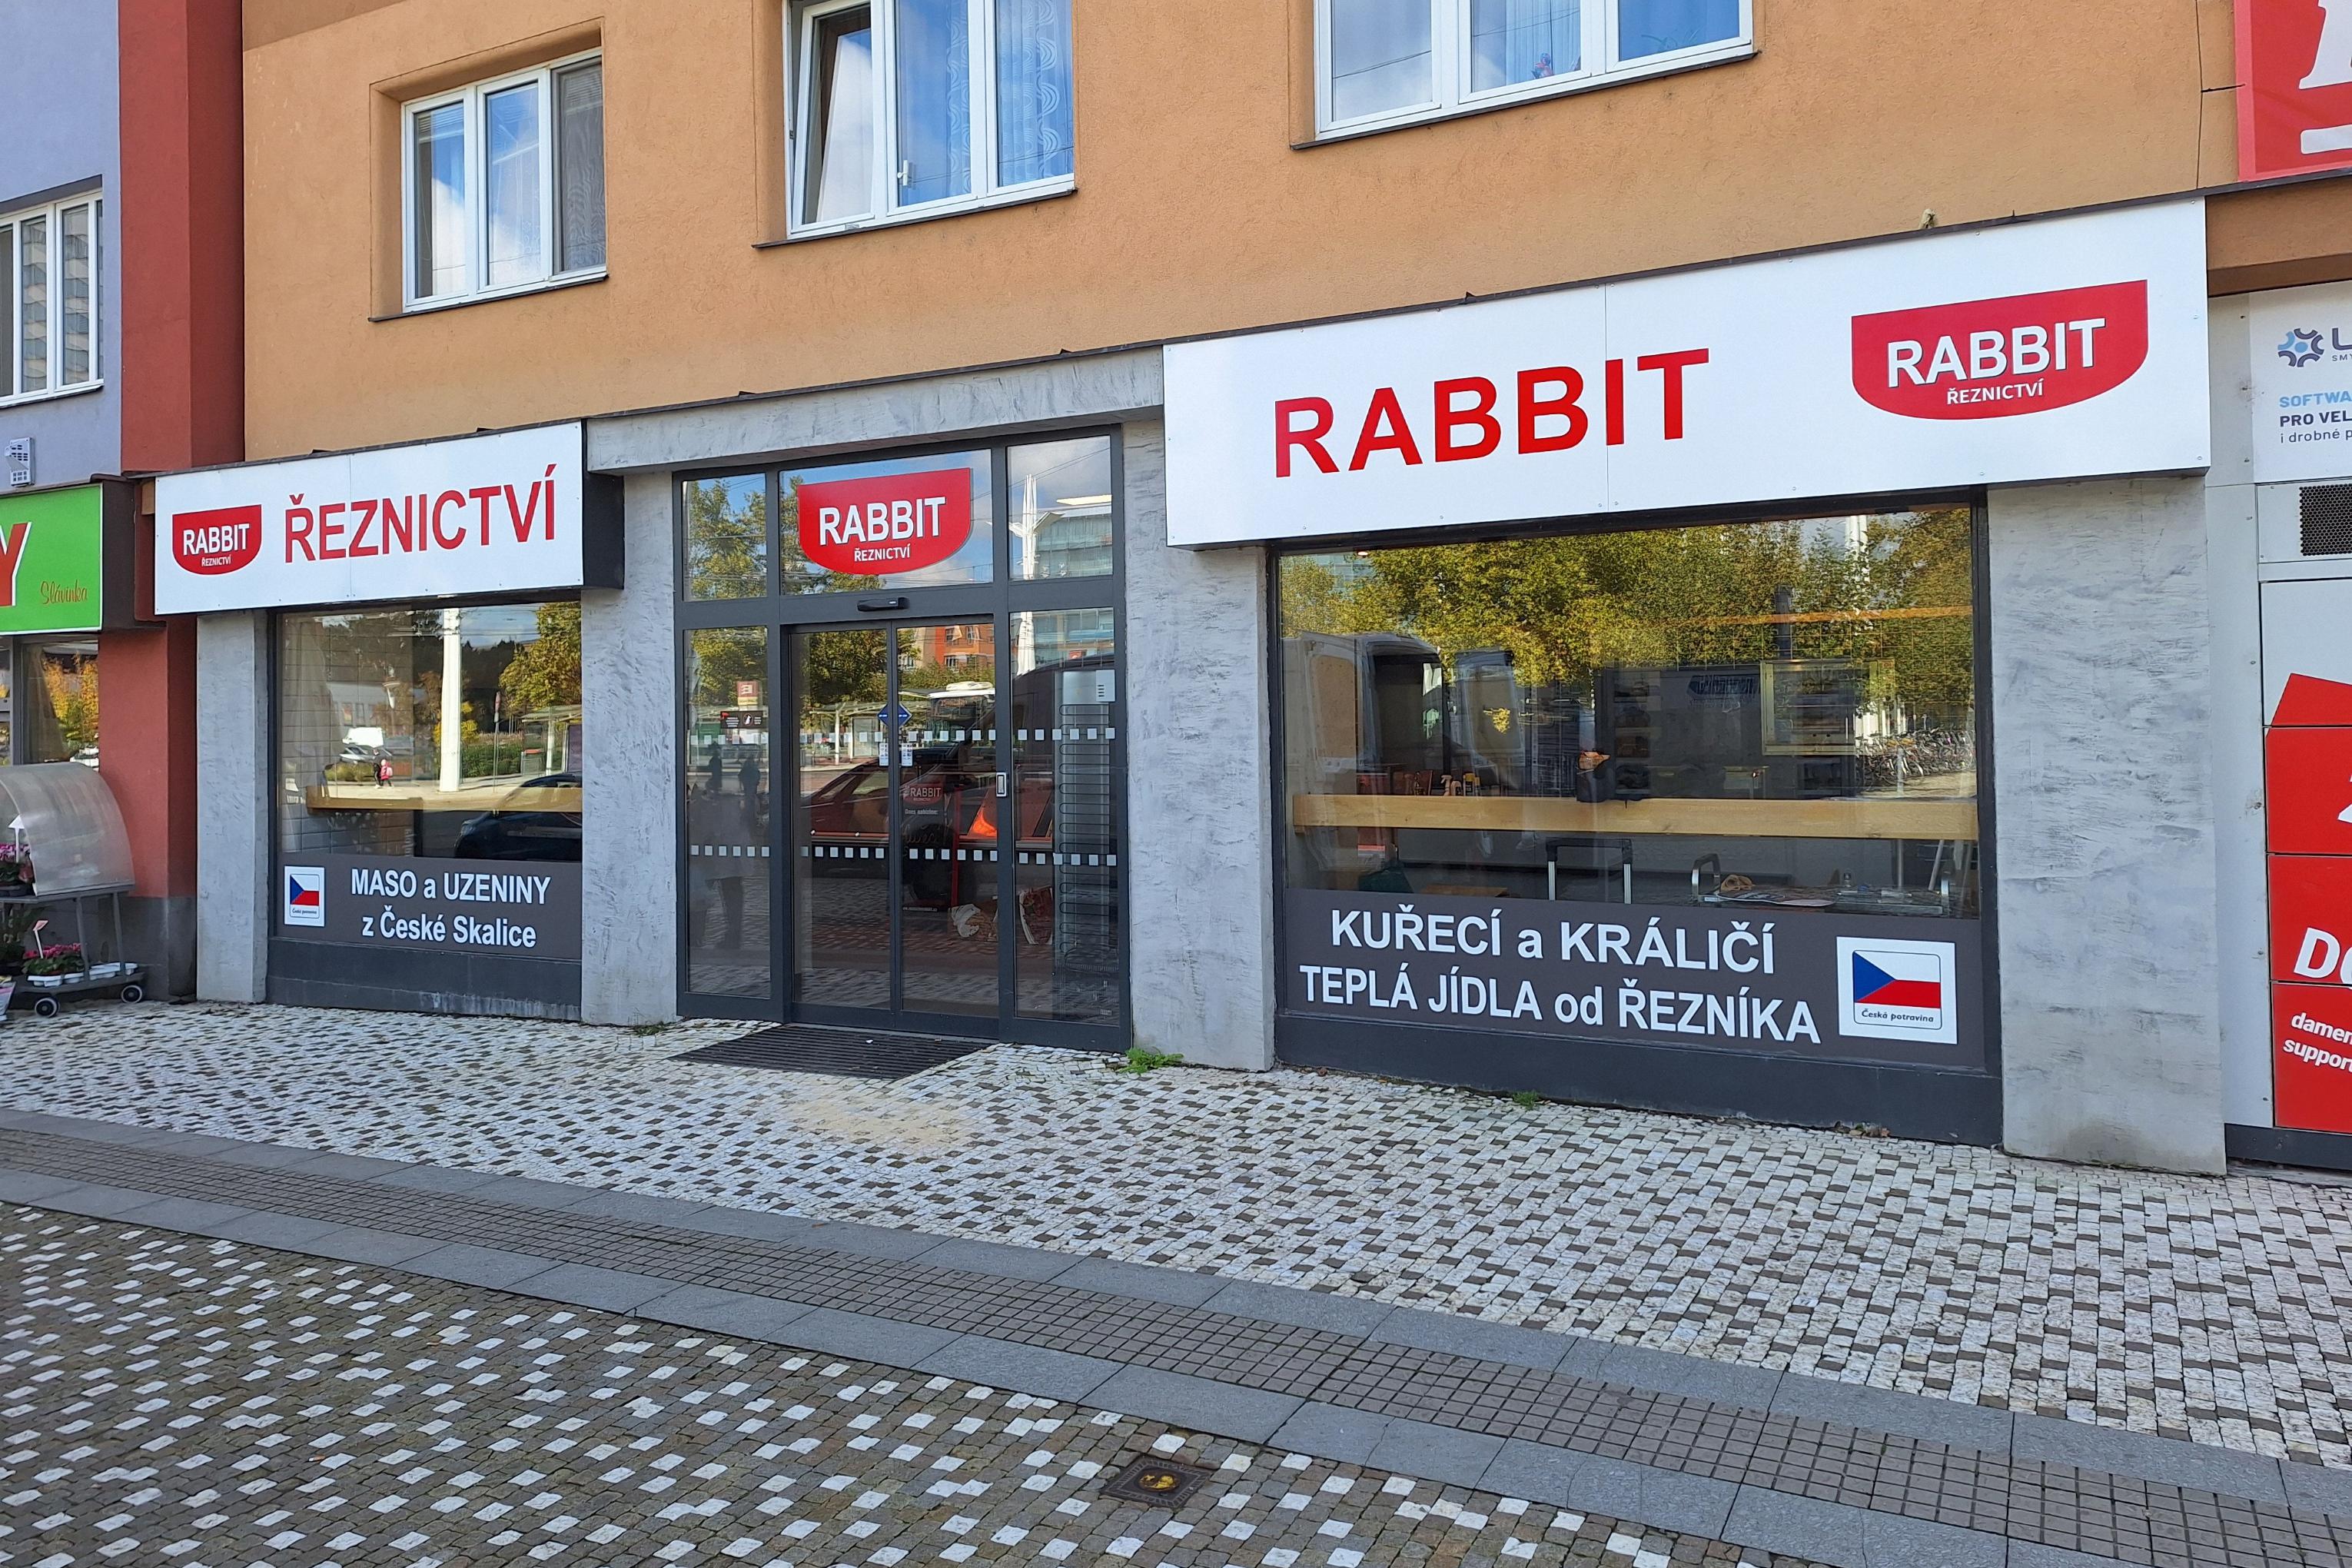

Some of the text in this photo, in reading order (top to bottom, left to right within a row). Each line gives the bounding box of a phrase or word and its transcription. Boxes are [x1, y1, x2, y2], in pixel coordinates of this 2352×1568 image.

[1888, 318, 2106, 387] RABBIT
[1947, 379, 2044, 405] ŘEZNICTVÍ
[1275, 348, 1709, 477] RABBIT
[2280, 414, 2314, 427] PRO
[2281, 433, 2284, 443] i
[2288, 429, 2340, 443] drobné
[285, 463, 556, 563] ŘEZNICTVÍ
[819, 497, 946, 546] RABBIT
[183, 523, 250, 556] RABBIT
[854, 543, 911, 562] ŘEZNICTVÍ
[201, 554, 231, 567] ŘEZNICTVÍ
[40, 579, 88, 605] Slávinka
[909, 787, 942, 798] RABBIT
[351, 868, 551, 905] MASO a UZENINY
[362, 905, 537, 948] z České Skalice
[1332, 904, 1776, 975] KUŘECÍ a KRÁLIČÍ
[1300, 962, 1822, 1045] TEPLÁ JÍDLA od ŘEZNÍKA
[1861, 1008, 1934, 1023] Česká potravina
